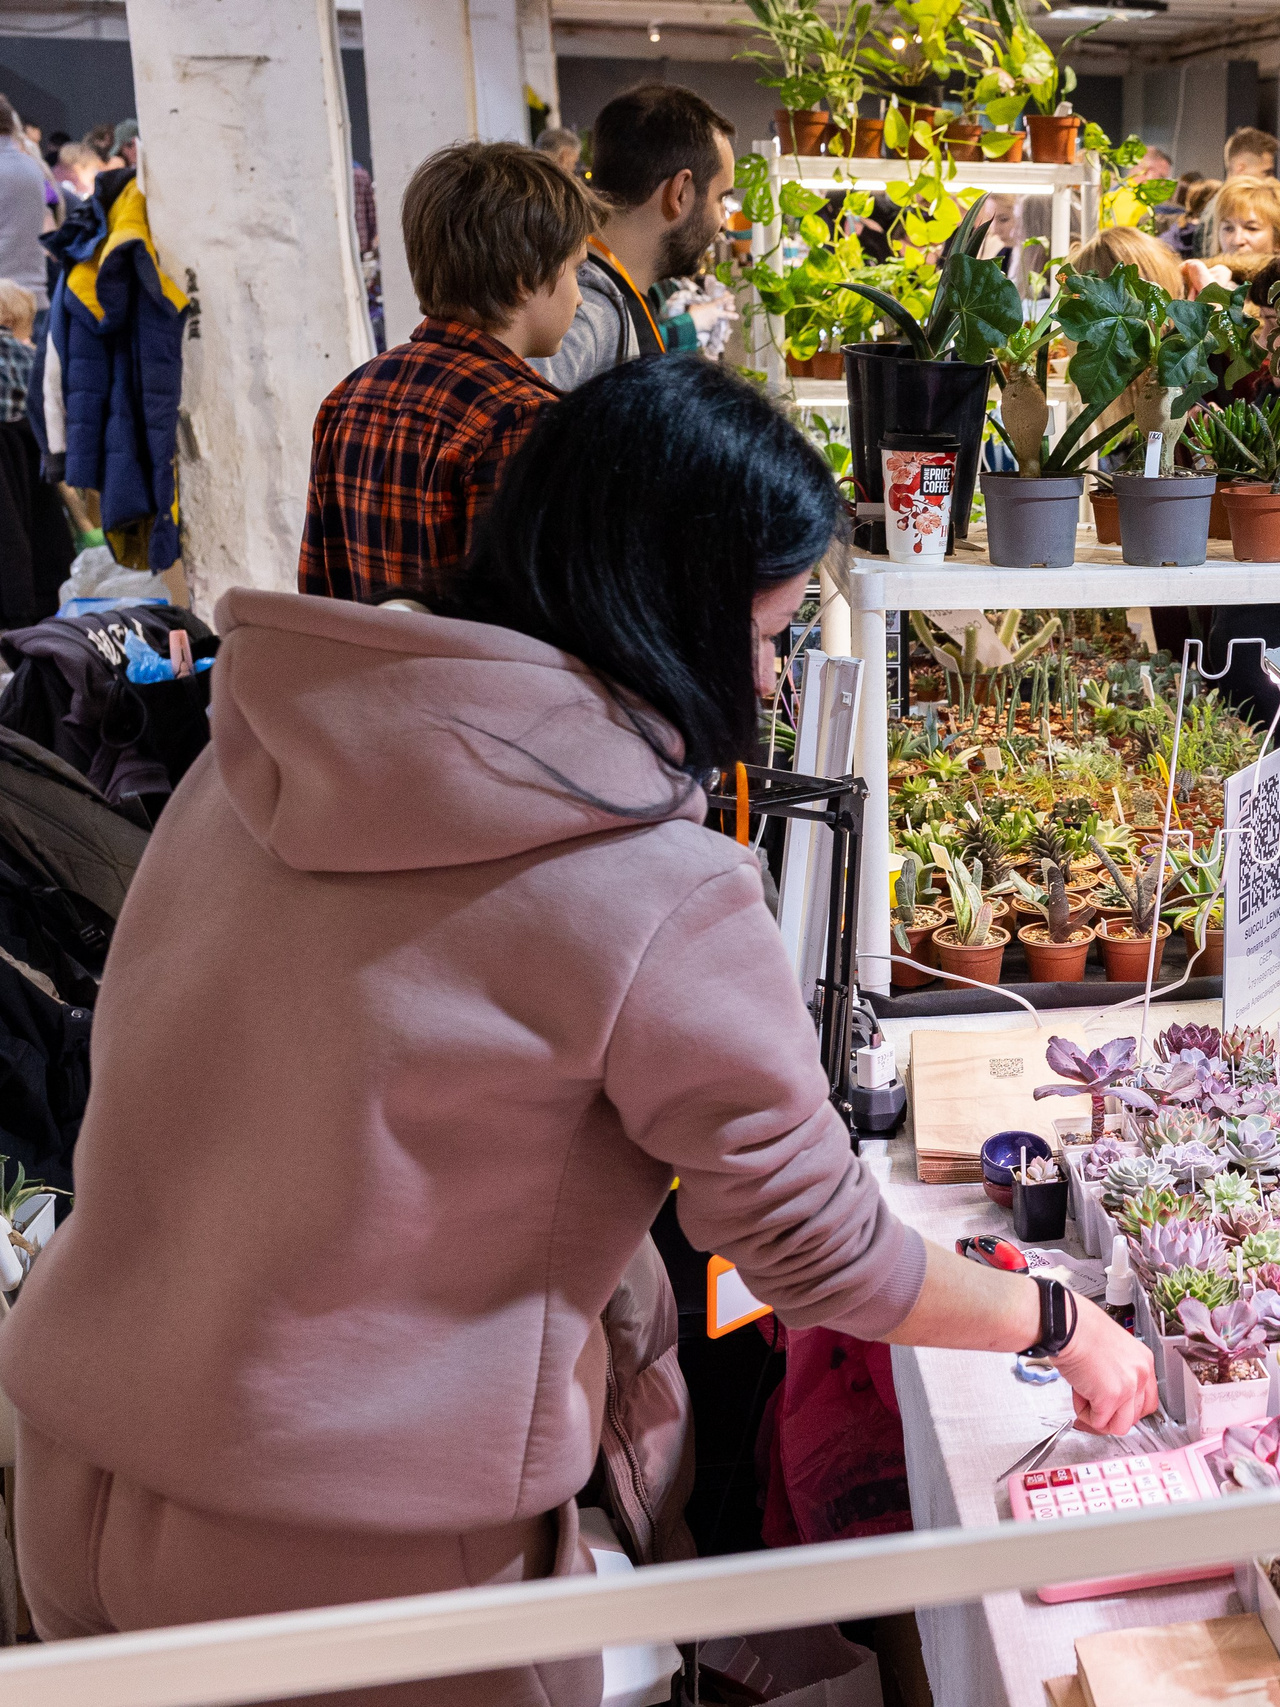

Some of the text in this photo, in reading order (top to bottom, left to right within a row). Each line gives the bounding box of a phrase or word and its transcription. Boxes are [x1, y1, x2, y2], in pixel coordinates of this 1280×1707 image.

[929, 467, 952, 480] PRICE
[923, 480, 950, 493] COFFEE
[1039, 1507, 1053, 1518] 00
